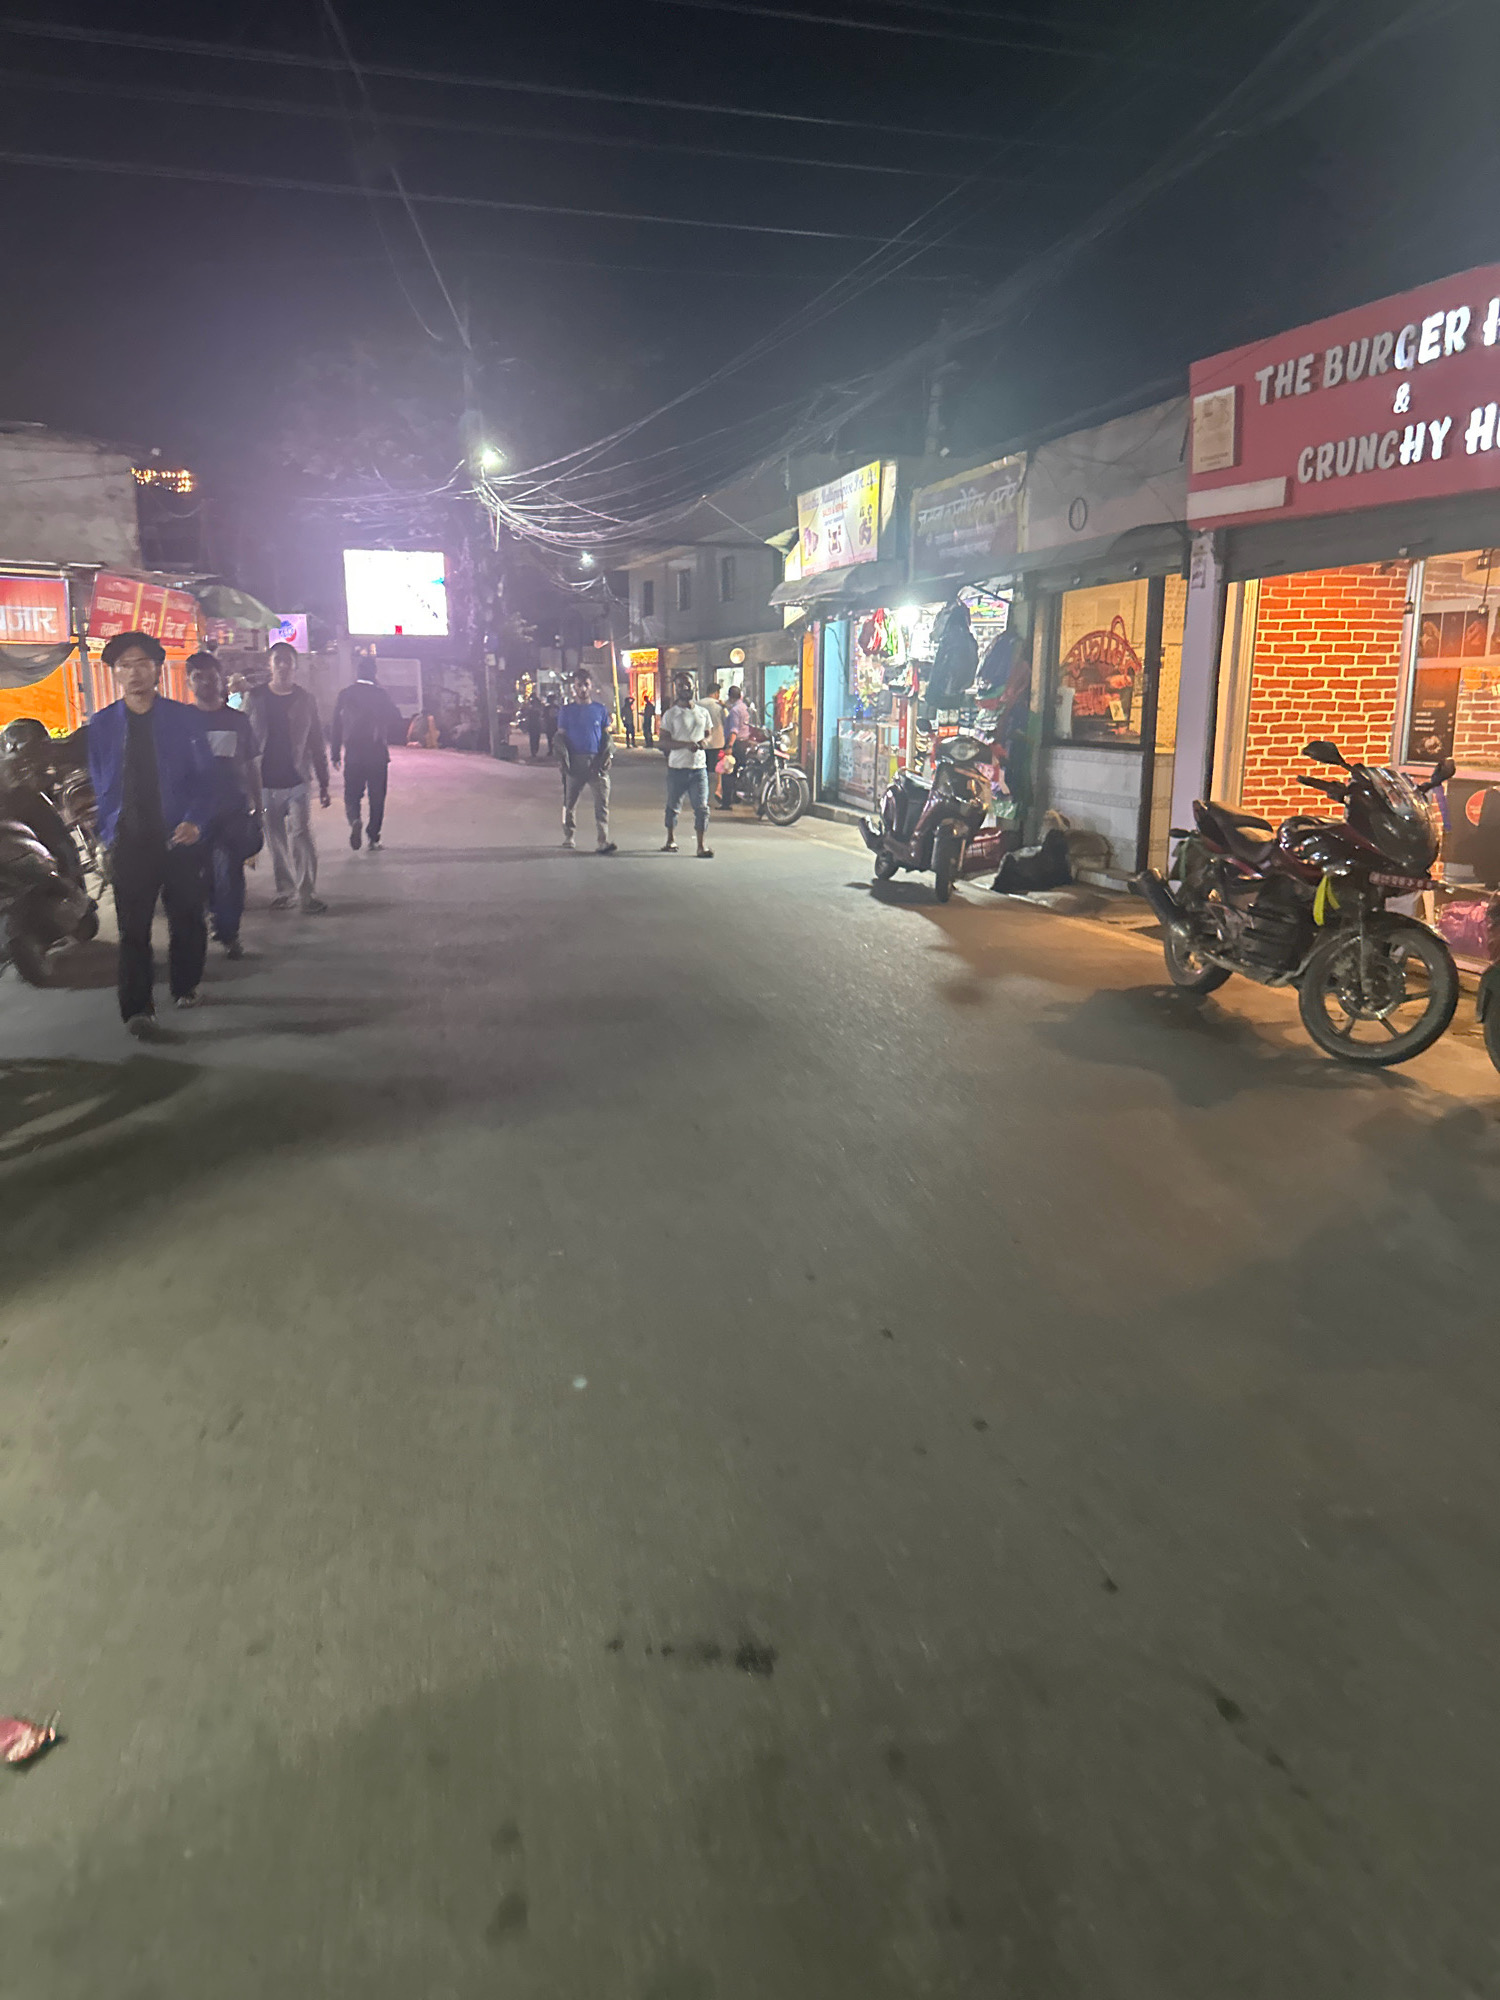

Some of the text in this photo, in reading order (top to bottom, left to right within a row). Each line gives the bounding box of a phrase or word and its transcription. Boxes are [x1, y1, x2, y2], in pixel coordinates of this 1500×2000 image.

[1255, 353, 1314, 405] THE
[1322, 305, 1471, 389] BURGER
[1392, 382, 1411, 415] &
[1297, 402, 1500, 484] CRUNCHY H
